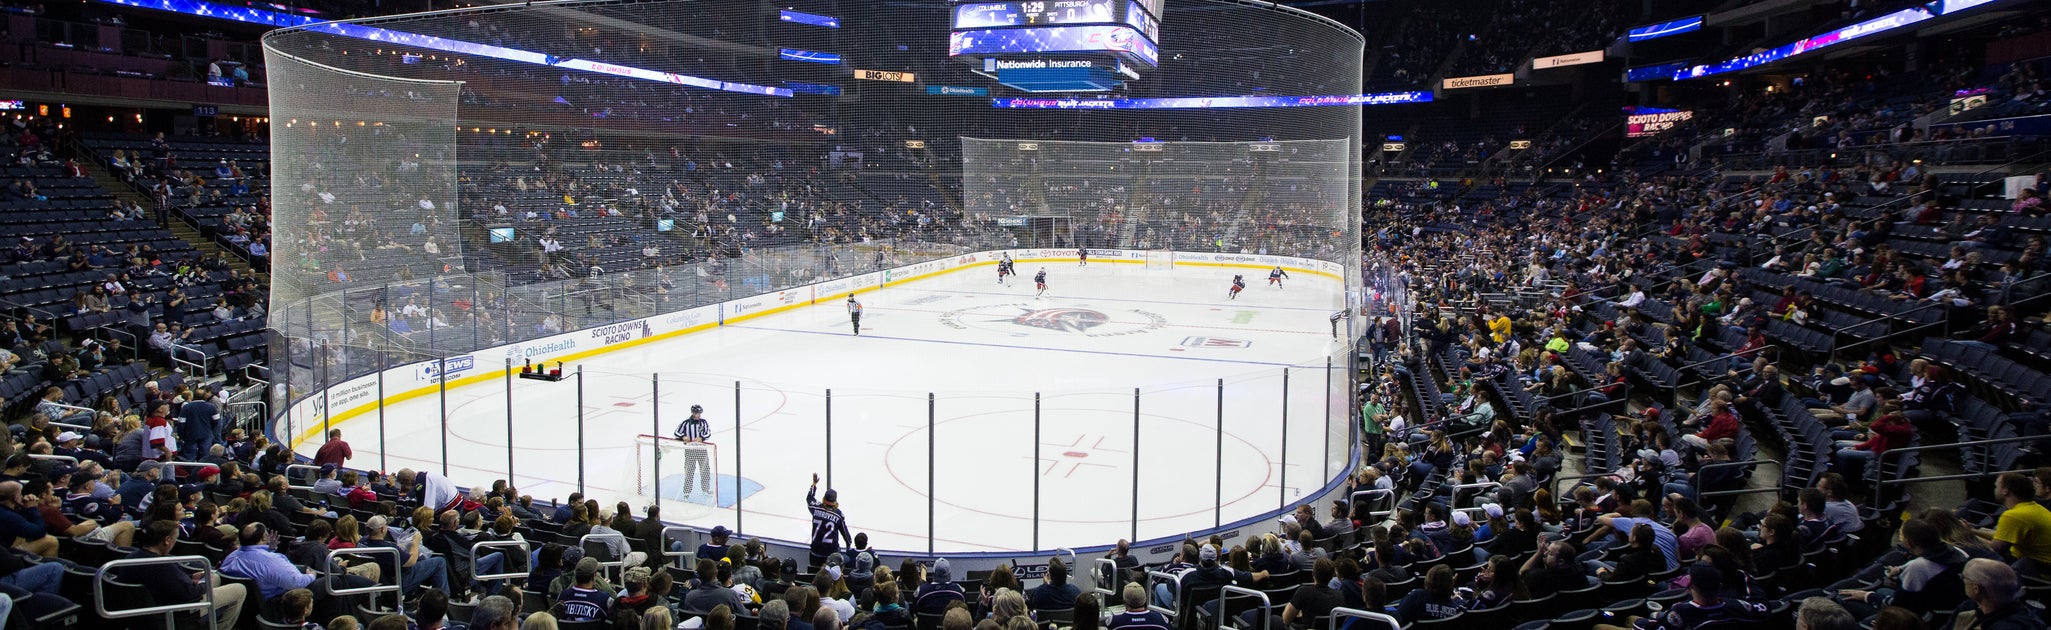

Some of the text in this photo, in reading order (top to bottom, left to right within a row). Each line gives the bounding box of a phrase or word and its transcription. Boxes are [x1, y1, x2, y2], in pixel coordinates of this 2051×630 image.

[1022, 2, 1044, 13] 1:29
[989, 12, 995, 23] 1
[1067, 8, 1075, 20] 0
[997, 59, 1092, 69] Nationwide Insurance
[1451, 77, 1501, 87] ticketmaster
[1627, 114, 1658, 124] SCIOTO
[592, 320, 642, 338] SCIOTO DOWNS
[605, 332, 631, 345] RACINO
[525, 339, 576, 358] OhioHealth
[812, 519, 835, 543] 72
[1426, 604, 1440, 613] BLUE
